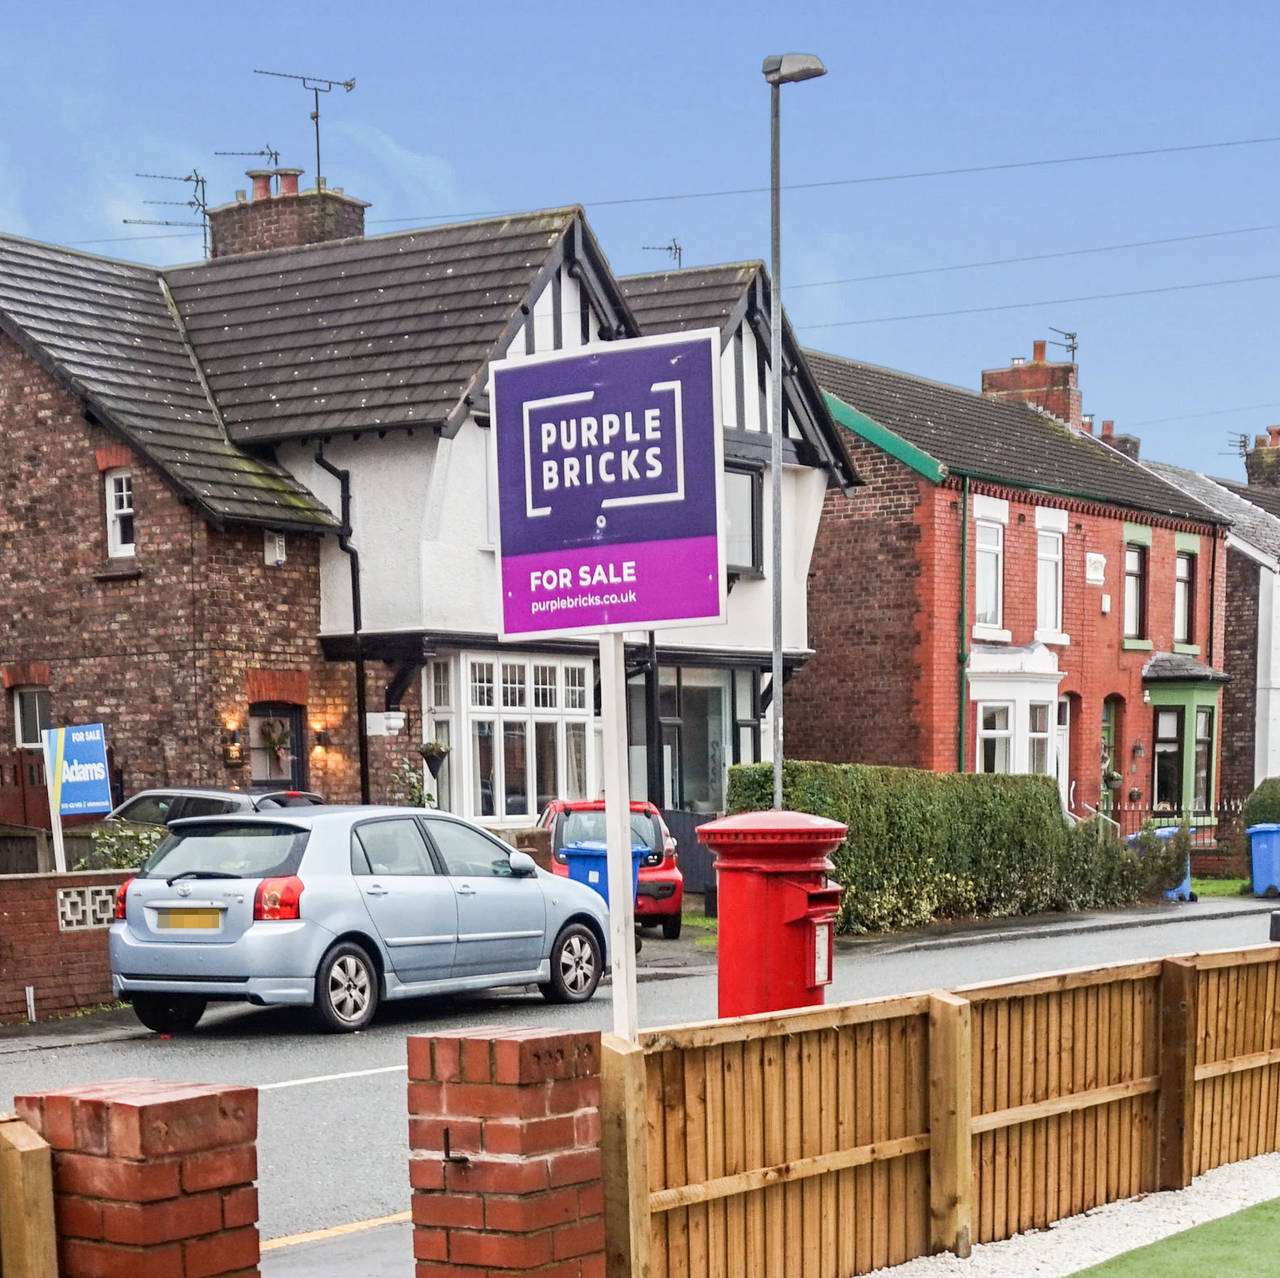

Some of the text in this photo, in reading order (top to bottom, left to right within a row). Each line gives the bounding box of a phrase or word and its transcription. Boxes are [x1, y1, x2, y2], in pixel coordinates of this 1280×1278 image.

[541, 408, 662, 453] PURPLE
[542, 447, 663, 490] BRICKS
[530, 561, 637, 592] FOR SALE
[531, 589, 637, 614] purplebricks.co.uk
[72, 730, 101, 743] FOR SALE
[62, 759, 106, 783] Adams
